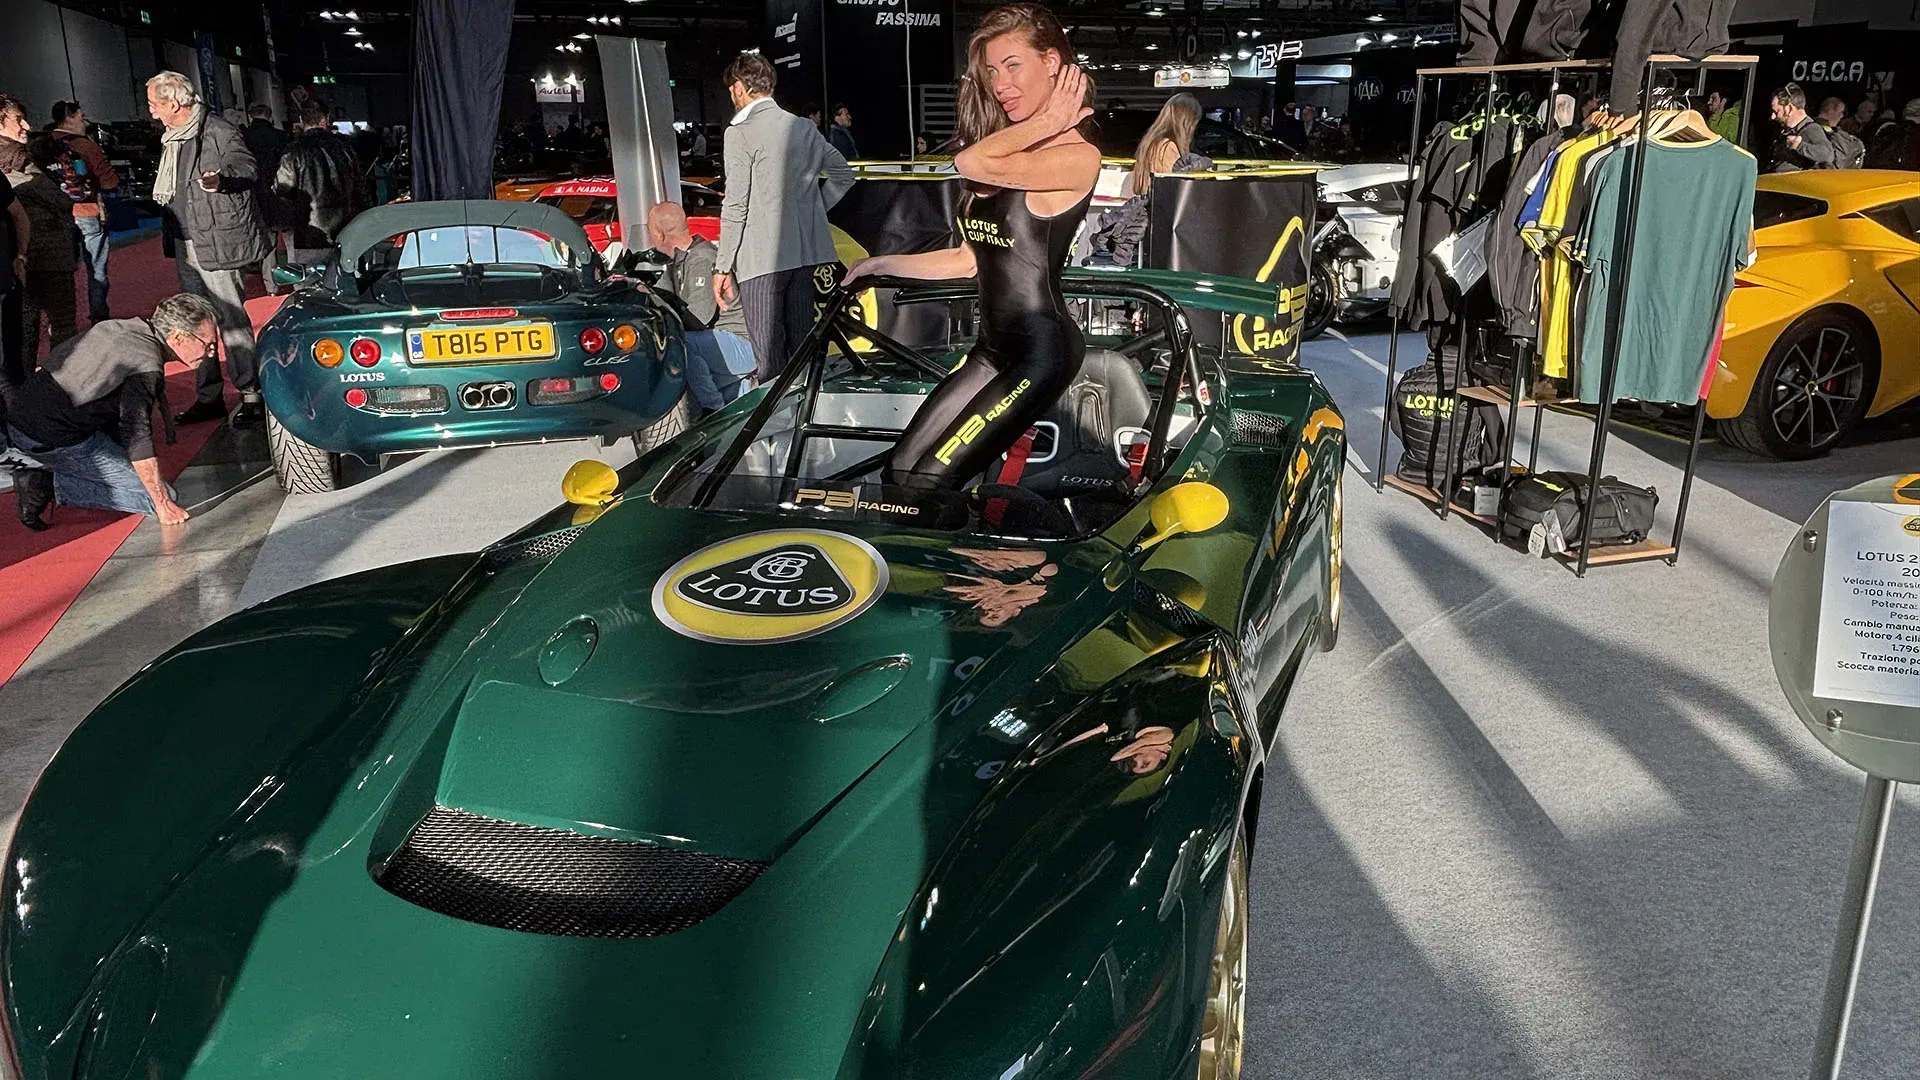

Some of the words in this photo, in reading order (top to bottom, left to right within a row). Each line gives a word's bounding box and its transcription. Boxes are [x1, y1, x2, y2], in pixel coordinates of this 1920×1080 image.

[876, 12, 940, 26] FASSINA
[965, 219, 999, 235] LOTUS
[968, 231, 985, 242] CUP
[986, 235, 1016, 248] ITALY
[432, 332, 489, 355] T815
[496, 330, 542, 352] PTG
[340, 372, 386, 383] LOTUS
[985, 378, 1031, 422] RACING
[1061, 475, 1114, 487] LOTUS
[795, 488, 856, 508] PB
[858, 501, 920, 516] RACING
[1857, 551, 1905, 563] LOTUS
[1843, 576, 1884, 587] Velocità
[688, 573, 839, 607] LOTUS
[1853, 587, 1883, 597] 0-100
[1886, 589, 1918, 600] km/h:
[1871, 599, 1918, 610] Potenza:
[1890, 611, 1919, 621] Peso:
[1843, 618, 1883, 629] Cambio
[1855, 630, 1892, 641] Motore
[1895, 633, 1902, 641] 4
[1892, 643, 1920, 654] 1.796
[1860, 651, 1907, 663] Trazione
[1837, 660, 1875, 671] Scocca
